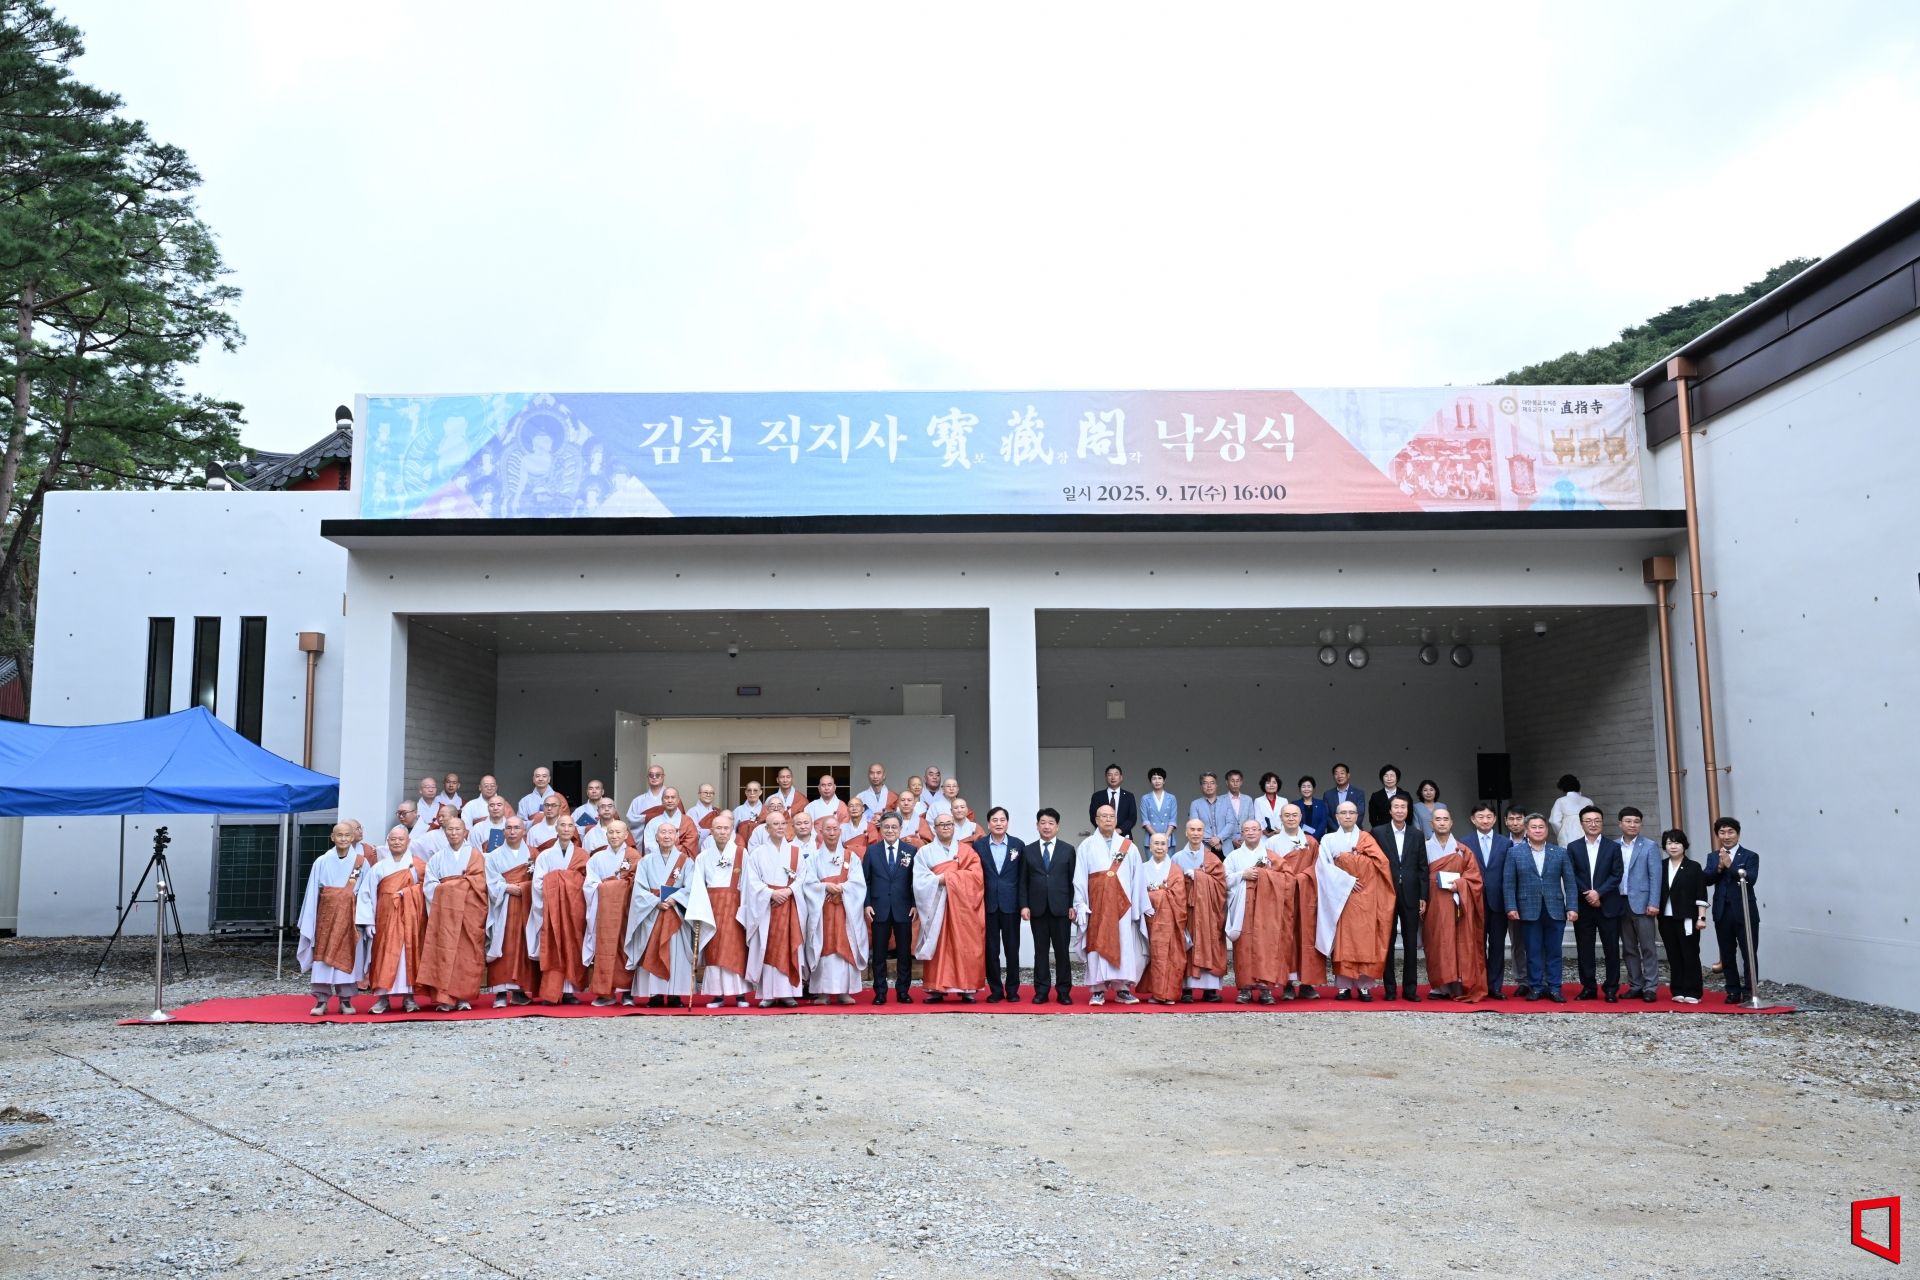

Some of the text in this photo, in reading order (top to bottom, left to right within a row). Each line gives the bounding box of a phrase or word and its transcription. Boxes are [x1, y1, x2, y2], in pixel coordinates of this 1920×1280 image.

[1561, 398, 1604, 415] 直指寺
[639, 415, 734, 465] 김천
[757, 414, 908, 465] 직지사
[1155, 412, 1295, 463] 낙성식
[1062, 484, 1288, 502] 일시 2025. 9. 17(수) 16:00
